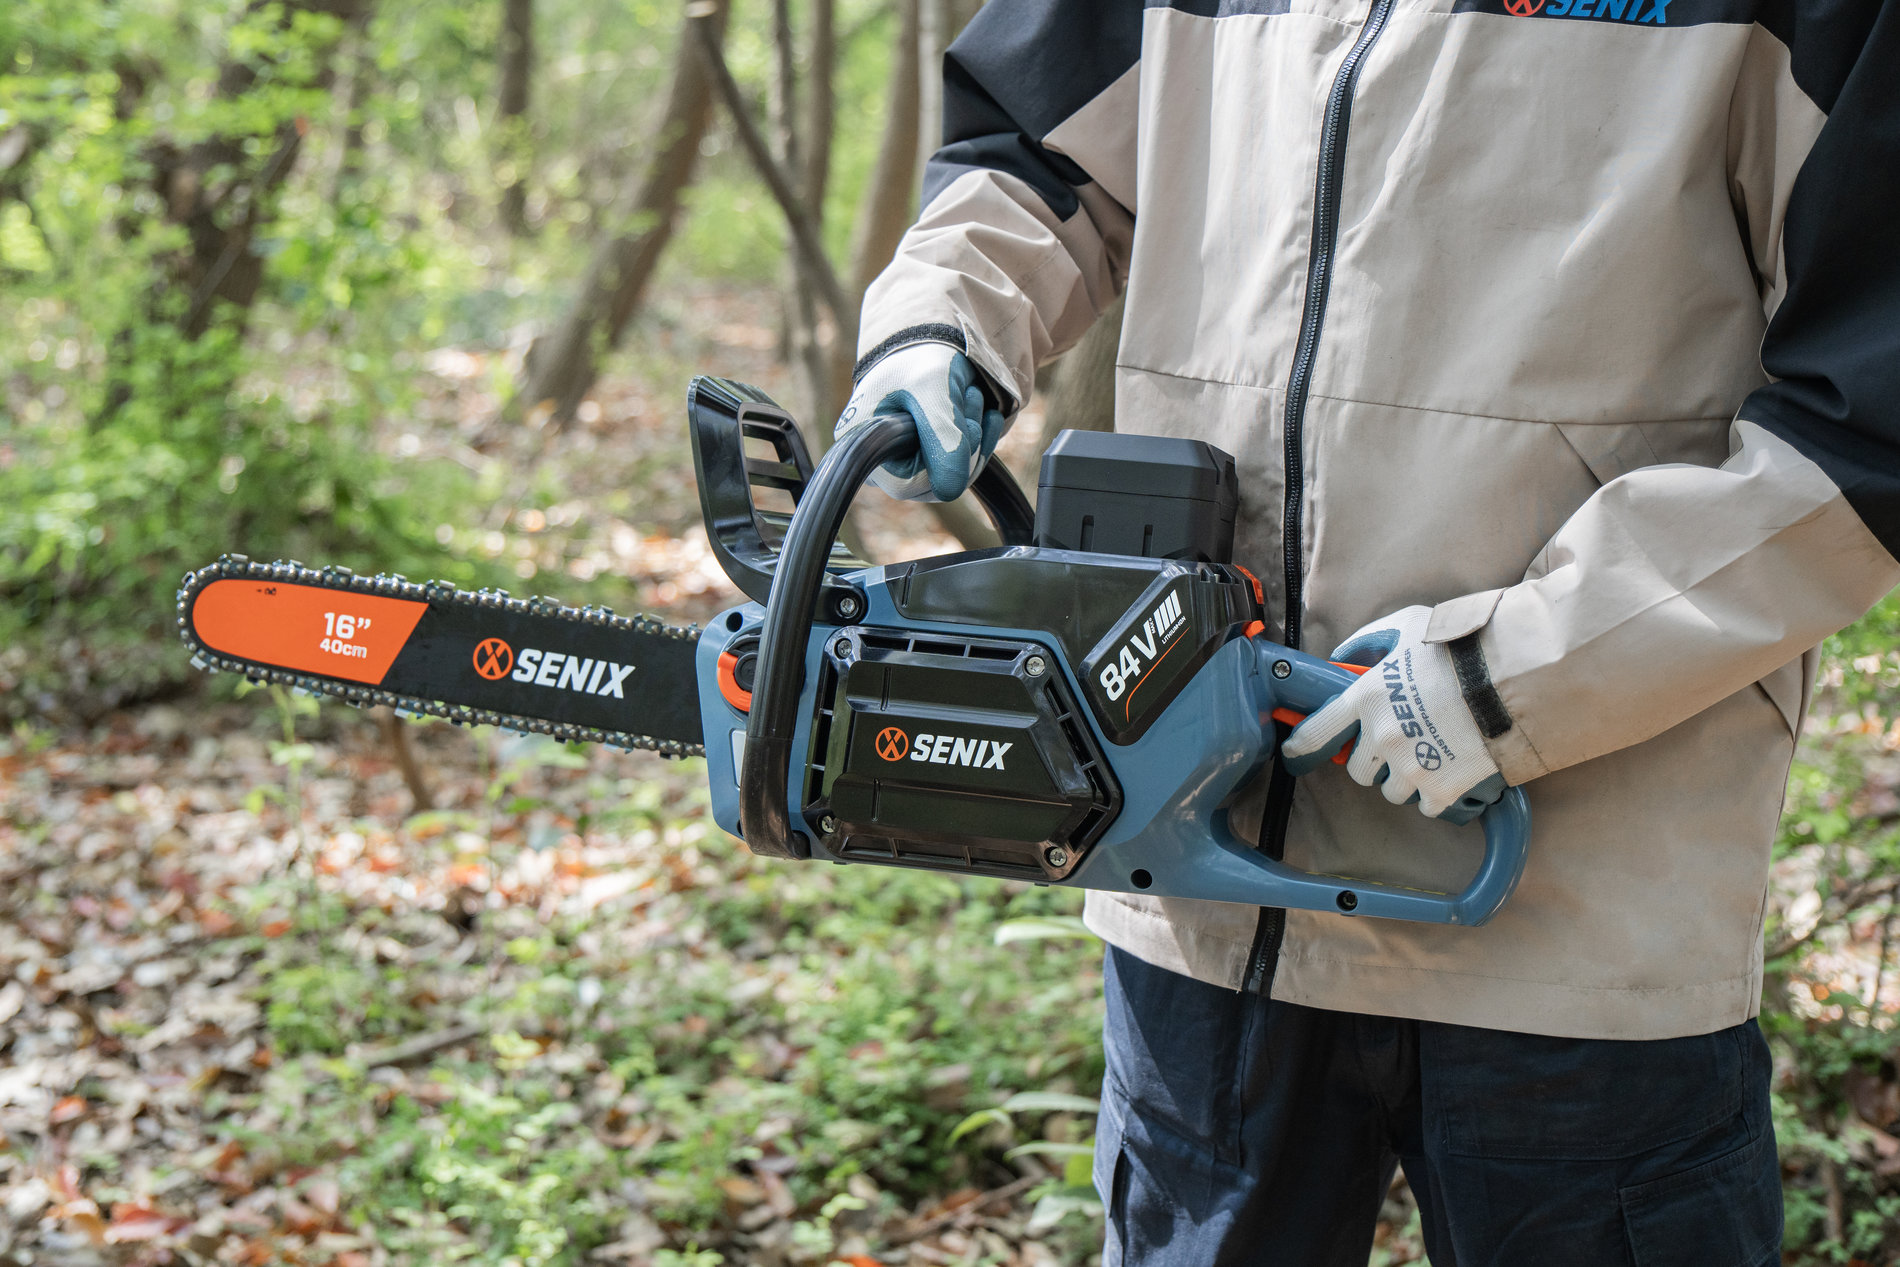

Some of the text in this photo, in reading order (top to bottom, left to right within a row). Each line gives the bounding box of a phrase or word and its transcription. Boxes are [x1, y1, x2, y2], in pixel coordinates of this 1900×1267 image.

[319, 638, 367, 658] 40cm
[511, 648, 636, 699] SENIX
[1100, 619, 1157, 701] 84V
[1383, 658, 1424, 739] SENIX
[1404, 647, 1456, 761] UNSTOPPABLE POWER
[910, 733, 1014, 770] SENIX
